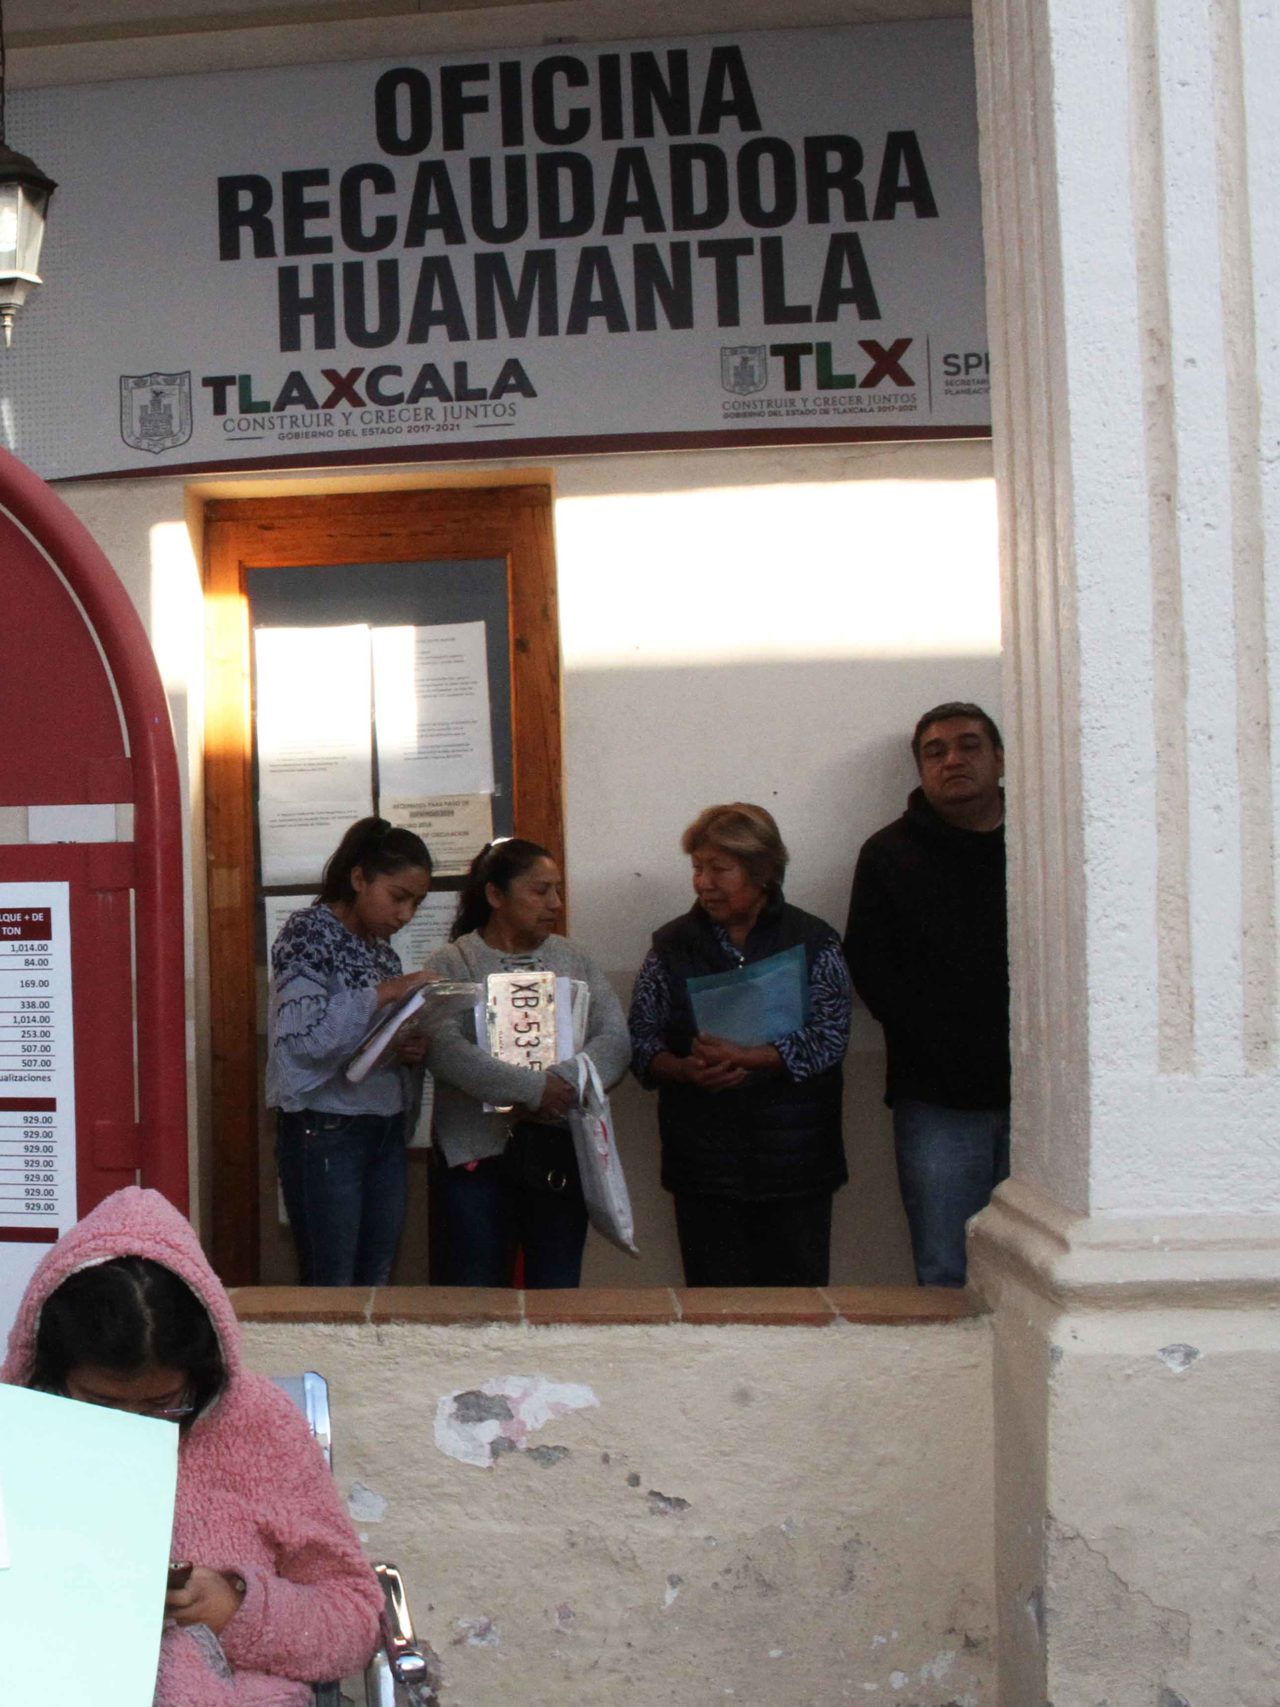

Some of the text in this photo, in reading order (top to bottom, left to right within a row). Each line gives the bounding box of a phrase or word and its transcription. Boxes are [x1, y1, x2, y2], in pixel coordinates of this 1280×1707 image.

[374, 45, 763, 156] OFICINA
[217, 130, 939, 261] RECAUDADORA
[278, 231, 881, 352] HUAMANTLA
[770, 338, 915, 391] TLX
[202, 358, 538, 416] TLAXCALA
[722, 393, 917, 411] CONSTRUIR Y CRECER JUNTOS
[223, 403, 518, 434] CONSTRUIR Y CRECER JUNTOS
[278, 423, 461, 441] GOBIERNO DEL ESTADO 2017-2021
[32, 913, 44, 921] DE
[1, 927, 21, 935] TON
[11, 944, 48, 952] 1,014.00
[20, 980, 49, 988] 169.00
[21, 1001, 50, 1009] 338.00
[13, 1016, 50, 1024] 1,014.00
[21, 1030, 50, 1038] 253.00
[22, 1059, 51, 1067] 507.00
[23, 1116, 53, 1124] 929.00
[23, 1131, 53, 1139] 929.00
[24, 1145, 53, 1153] 929.00
[24, 1160, 54, 1168] 929.00
[25, 1174, 54, 1182] 929.00
[25, 1188, 54, 1196] 929.00
[25, 1203, 55, 1211] 929.00
